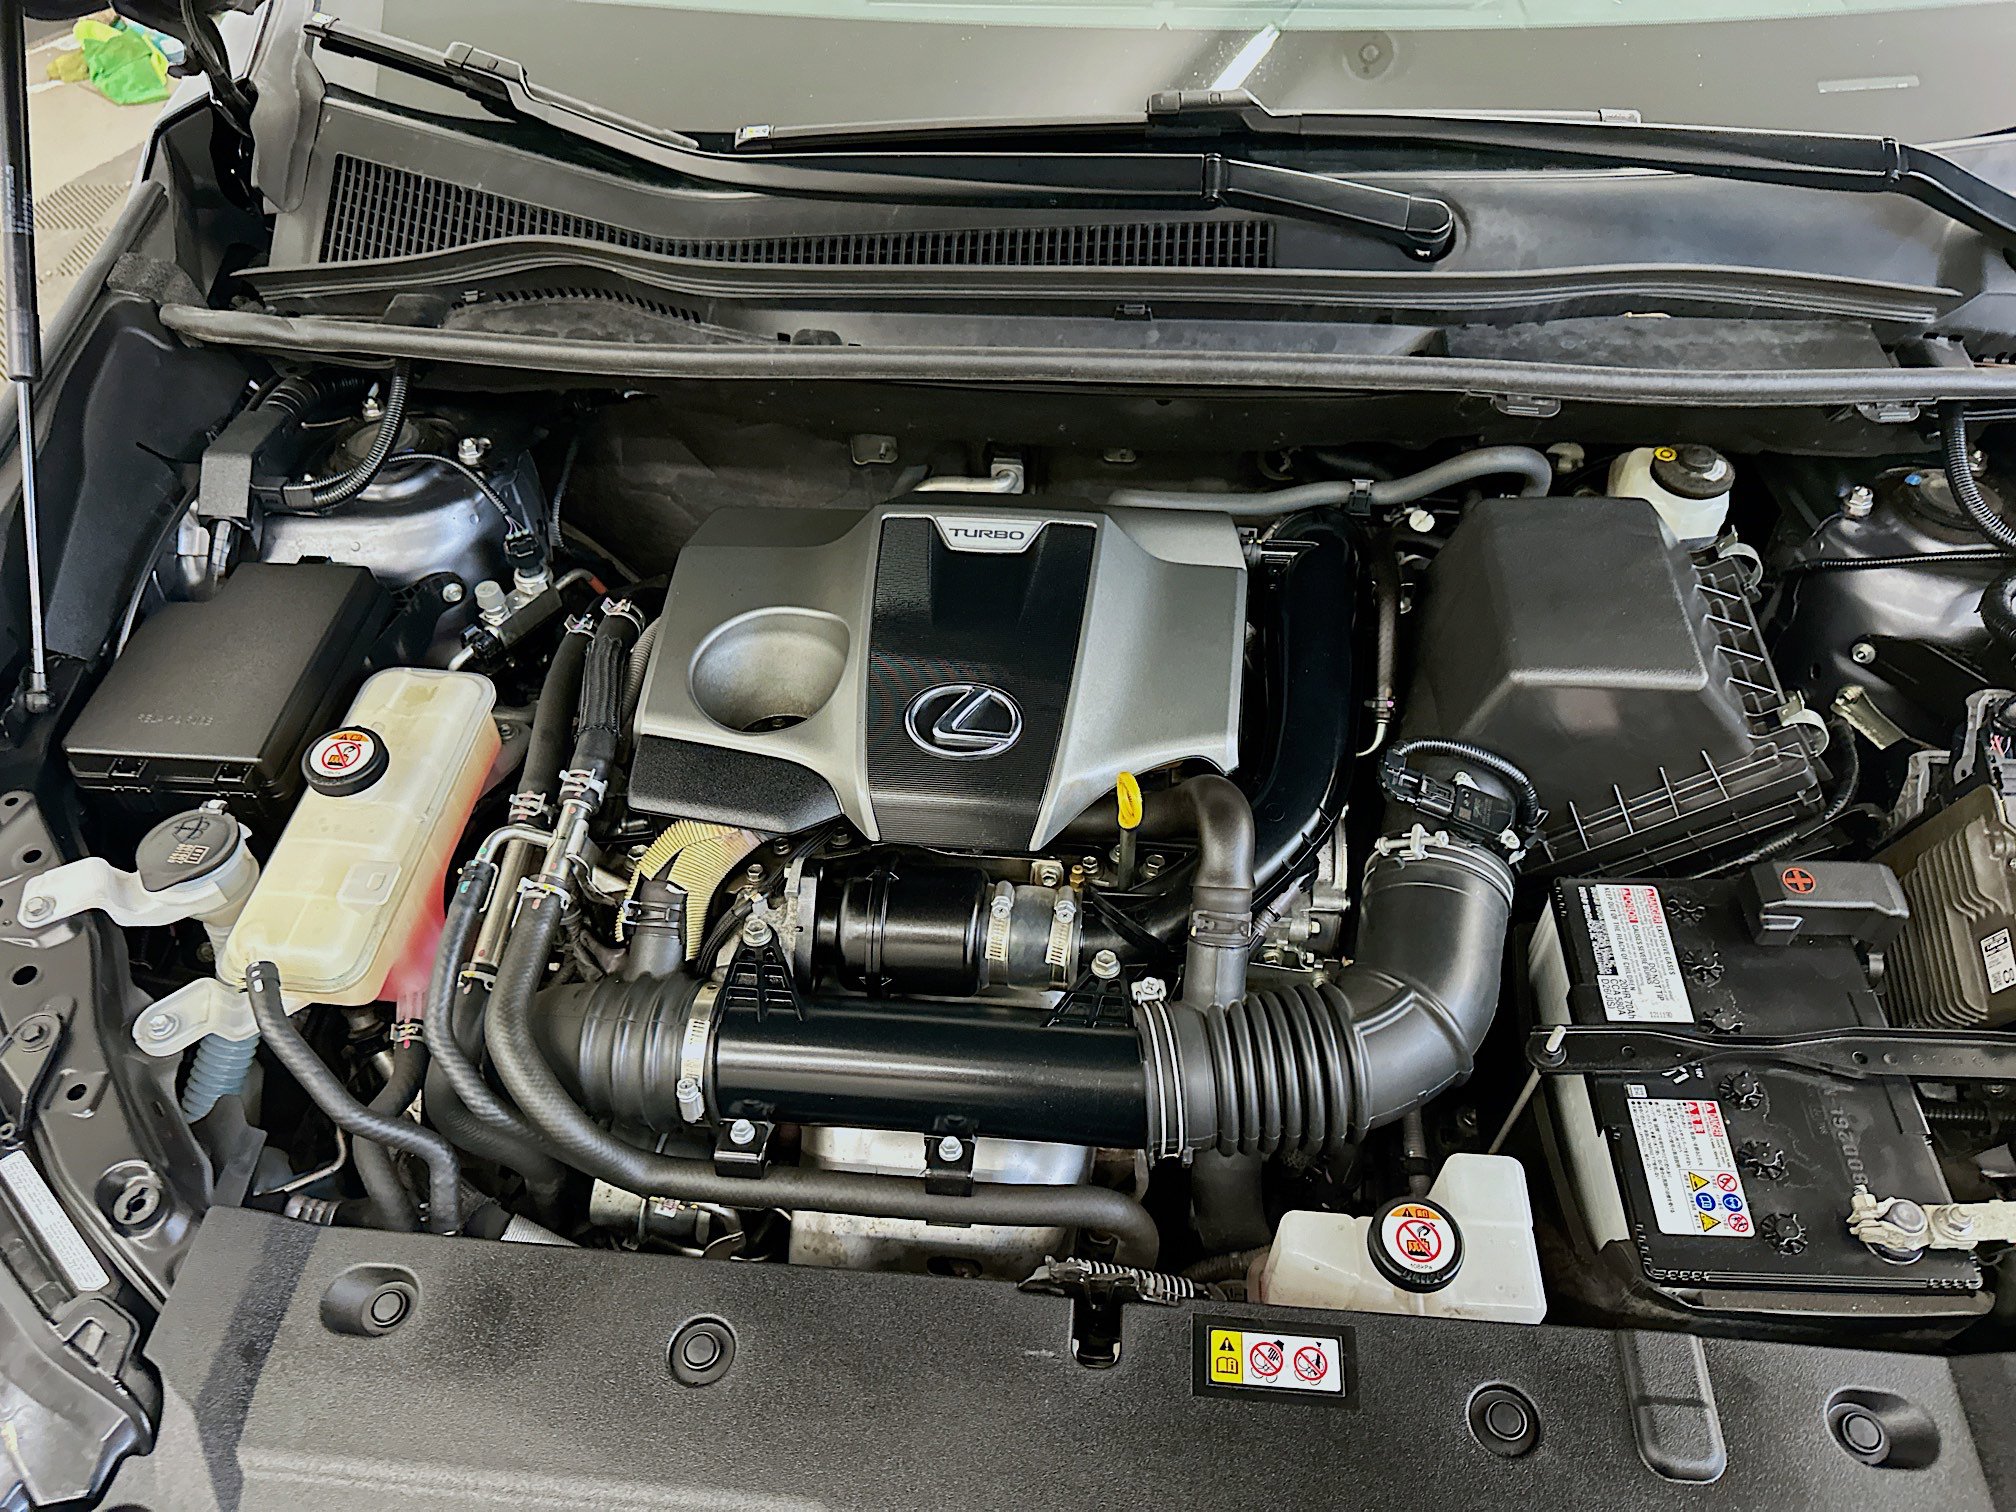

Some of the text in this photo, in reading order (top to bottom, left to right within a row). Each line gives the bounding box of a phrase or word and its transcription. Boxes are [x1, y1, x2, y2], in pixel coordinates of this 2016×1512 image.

[948, 527, 1025, 540] TURBO
[1604, 887, 1612, 900] KEEP
[1607, 902, 1615, 911] OUT
[1615, 934, 1625, 951] REACH
[1632, 925, 1642, 944] CAUSES
[1638, 945, 1648, 964] SEVERE
[1643, 966, 1653, 984] BURNS
[1656, 925, 1670, 954] EXPLOSIVE
[1665, 956, 1675, 975] GASES
[1623, 962, 1635, 991] CHILDREN
[1647, 963, 1664, 1000] DO NOT TIP
[1610, 979, 1626, 1015] CCA 580A
[1619, 979, 1631, 999] 20HR
[1625, 1000, 1636, 1019] 70Ah
